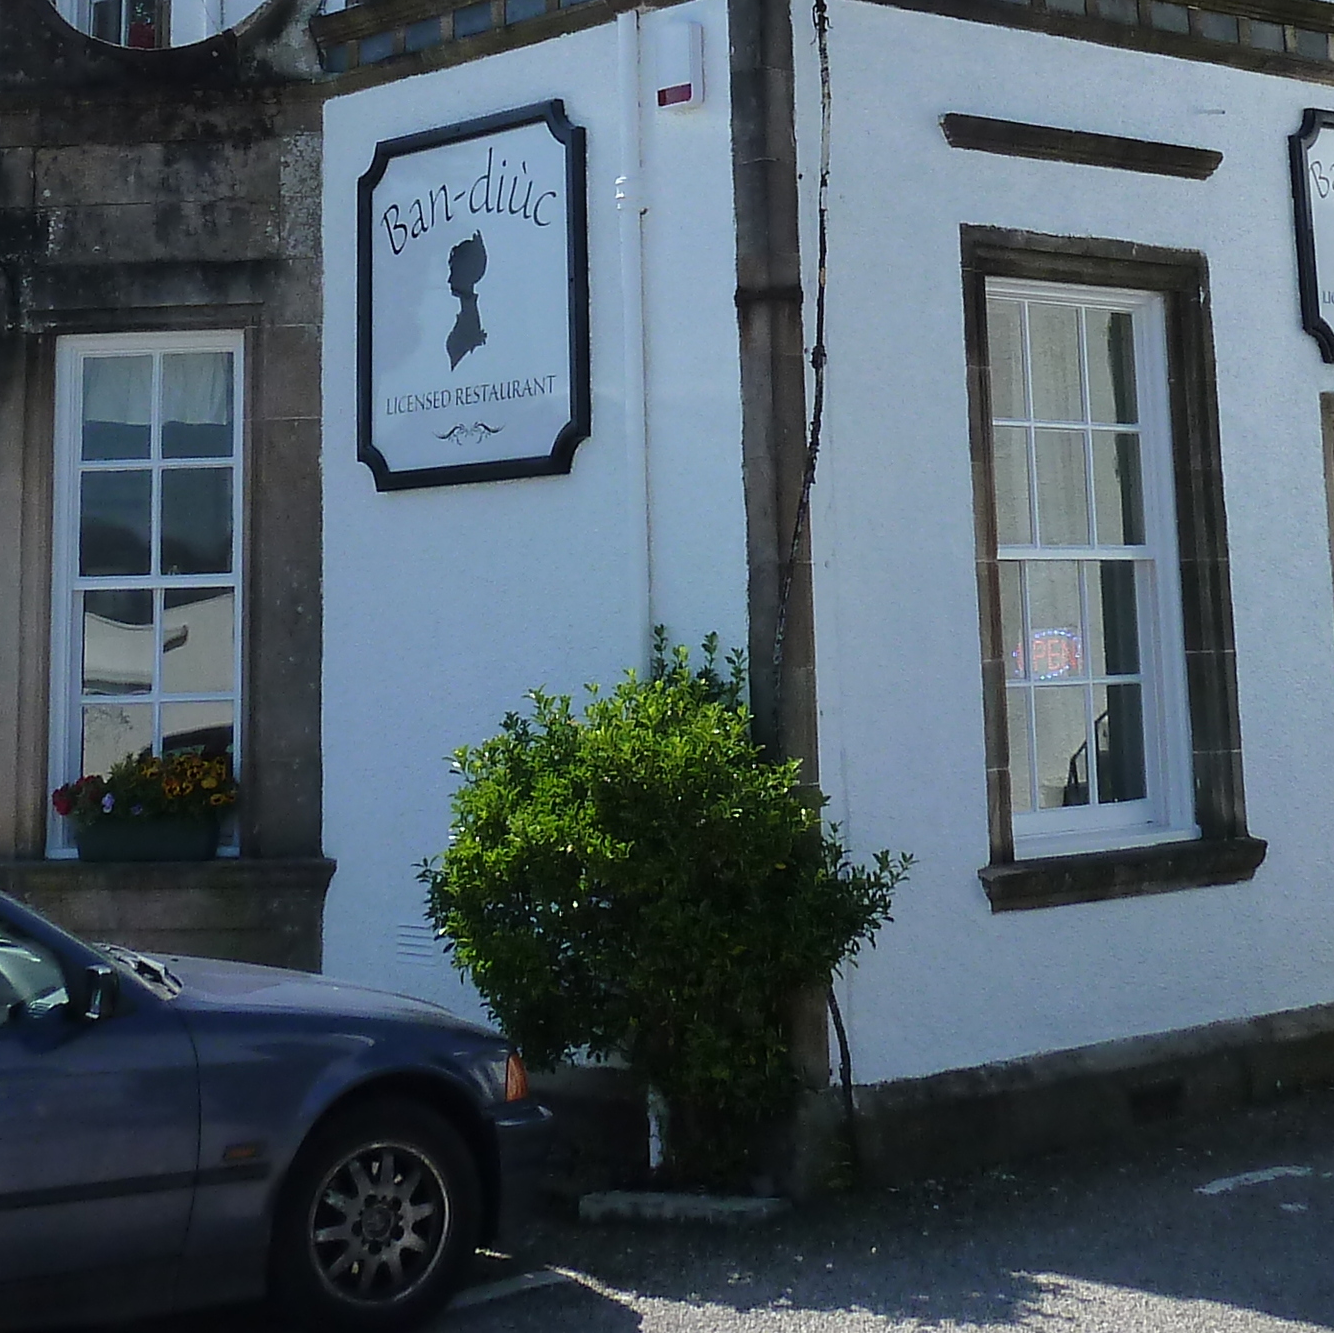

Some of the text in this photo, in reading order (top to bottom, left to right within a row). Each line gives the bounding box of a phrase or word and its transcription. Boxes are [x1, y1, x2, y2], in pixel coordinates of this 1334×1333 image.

[380, 147, 557, 255] Ban-diùc
[386, 375, 557, 416] LICENSED RESTAURANT
